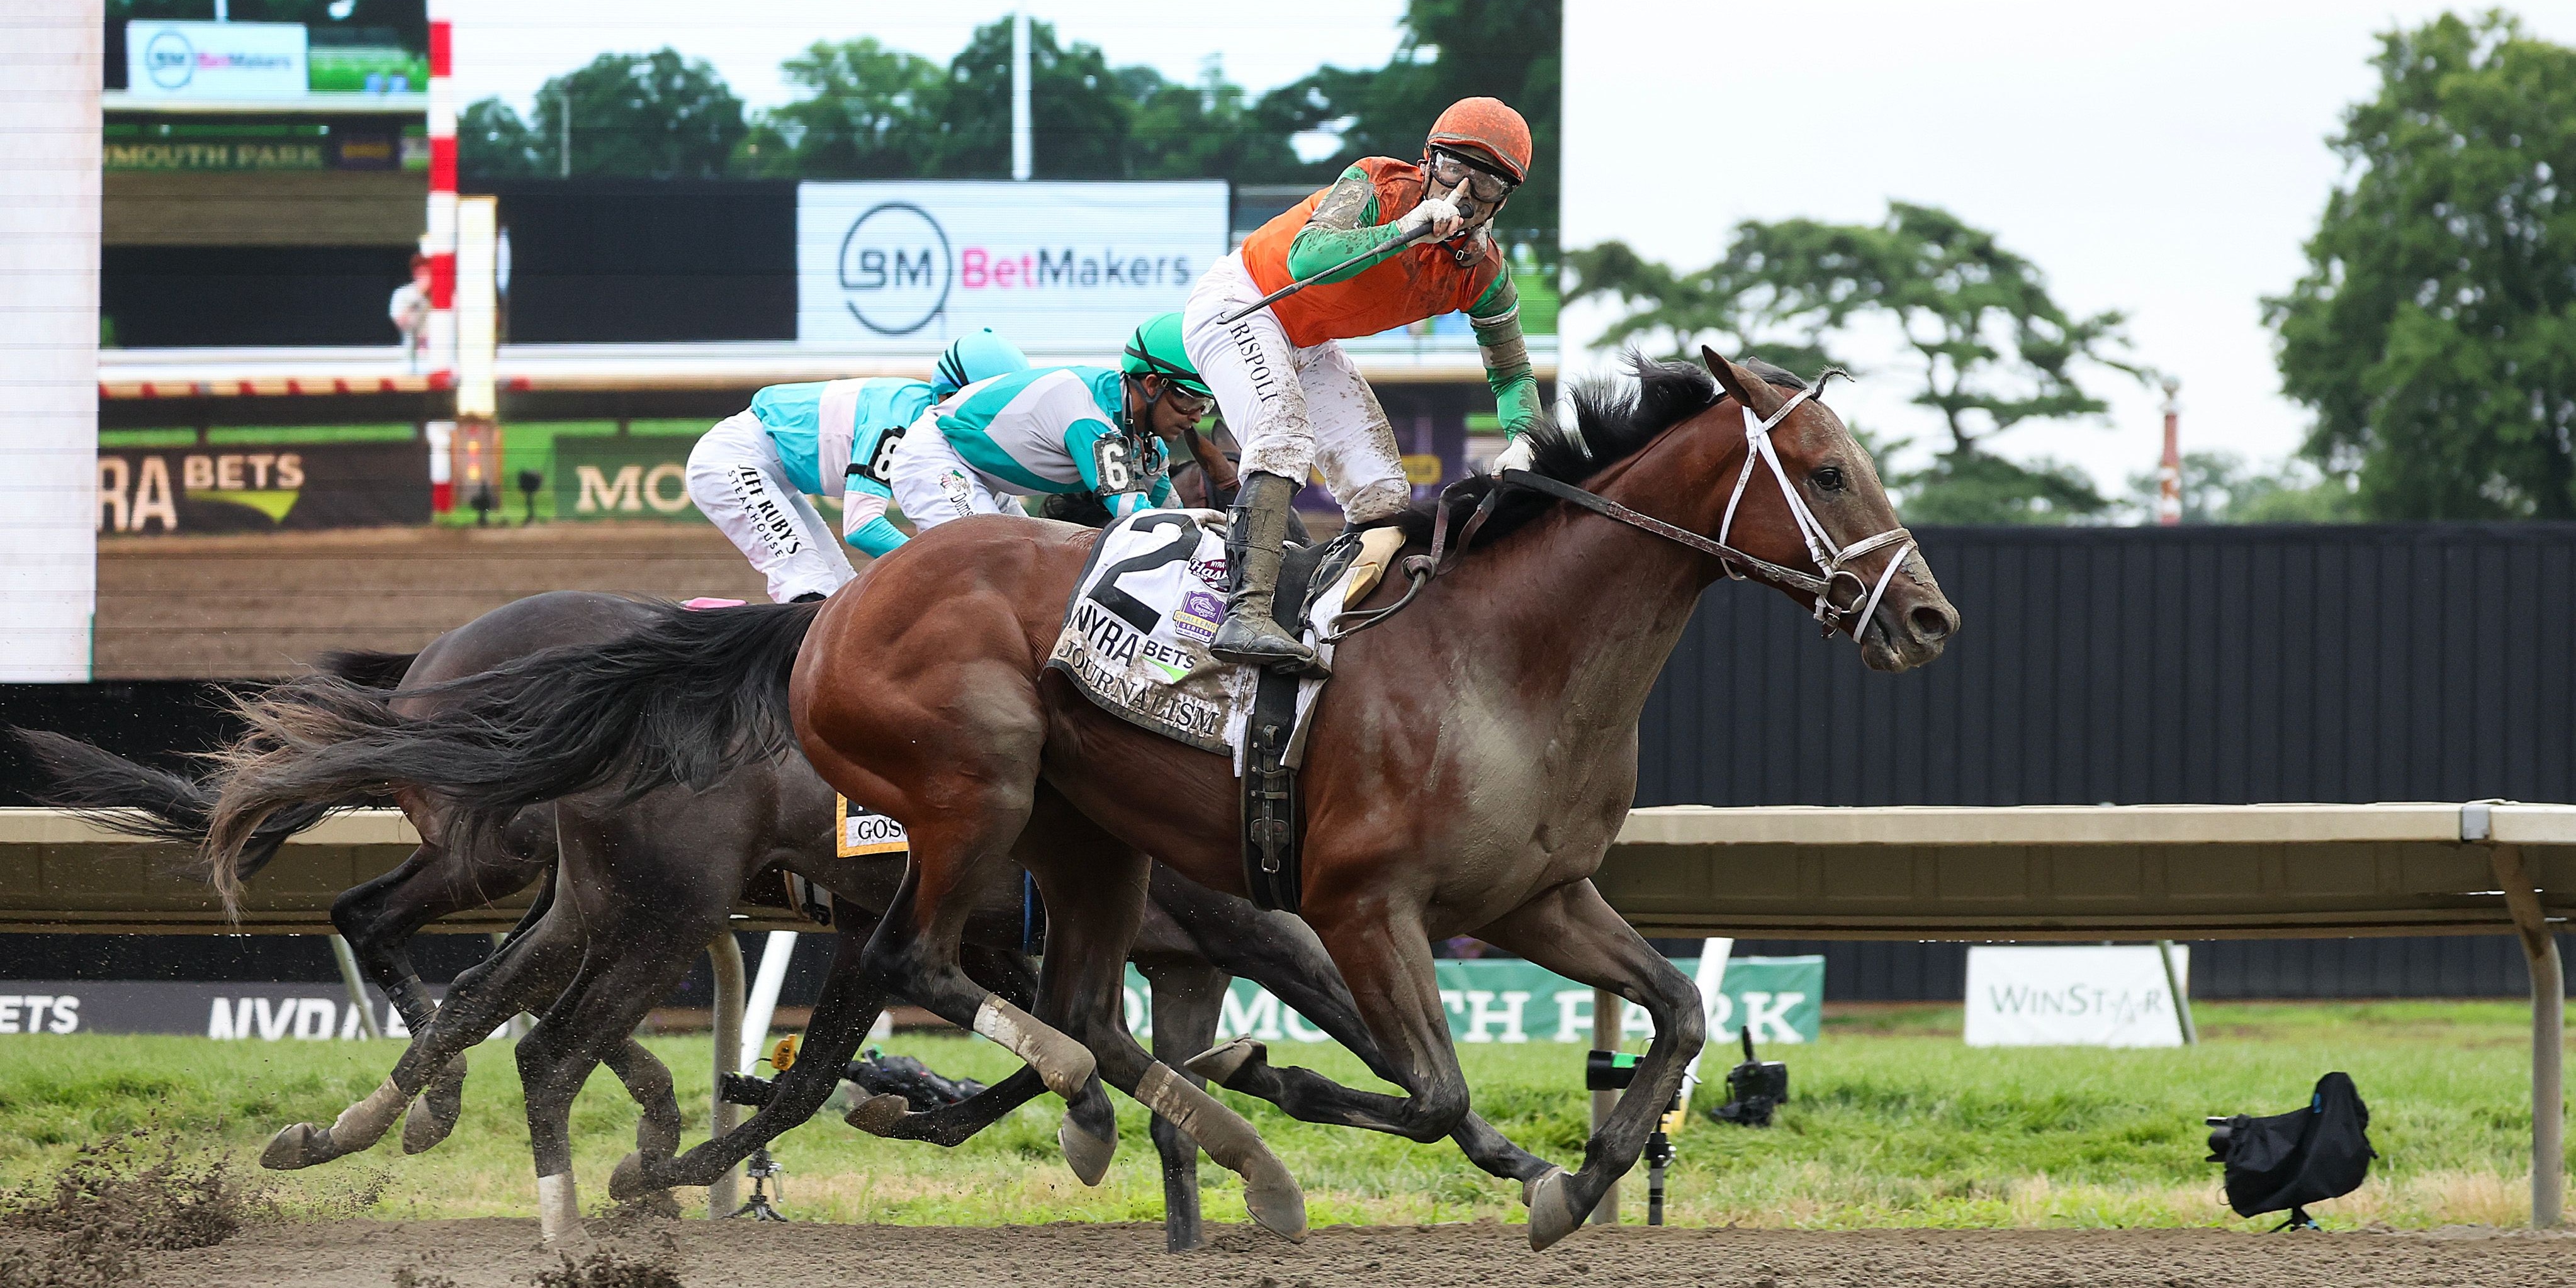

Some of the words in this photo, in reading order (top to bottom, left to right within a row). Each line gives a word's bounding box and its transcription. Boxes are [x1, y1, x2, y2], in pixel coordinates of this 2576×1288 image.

[961, 247, 1191, 289] BetMakers
[1229, 322, 1278, 404] RISPOLI
[183, 454, 306, 490] BETS
[873, 435, 903, 481] 8
[1102, 443, 1129, 490] 6
[728, 469, 784, 558] STEAKHOUSE
[738, 464, 765, 497] JEFF
[758, 500, 803, 554] RUBY'S
[1086, 513, 1203, 636] 2
[1069, 604, 1139, 668] NYRA
[1142, 639, 1198, 669] BETS
[1181, 622, 1209, 636] SERIES
[1057, 640, 1220, 735] JOURNALISM
